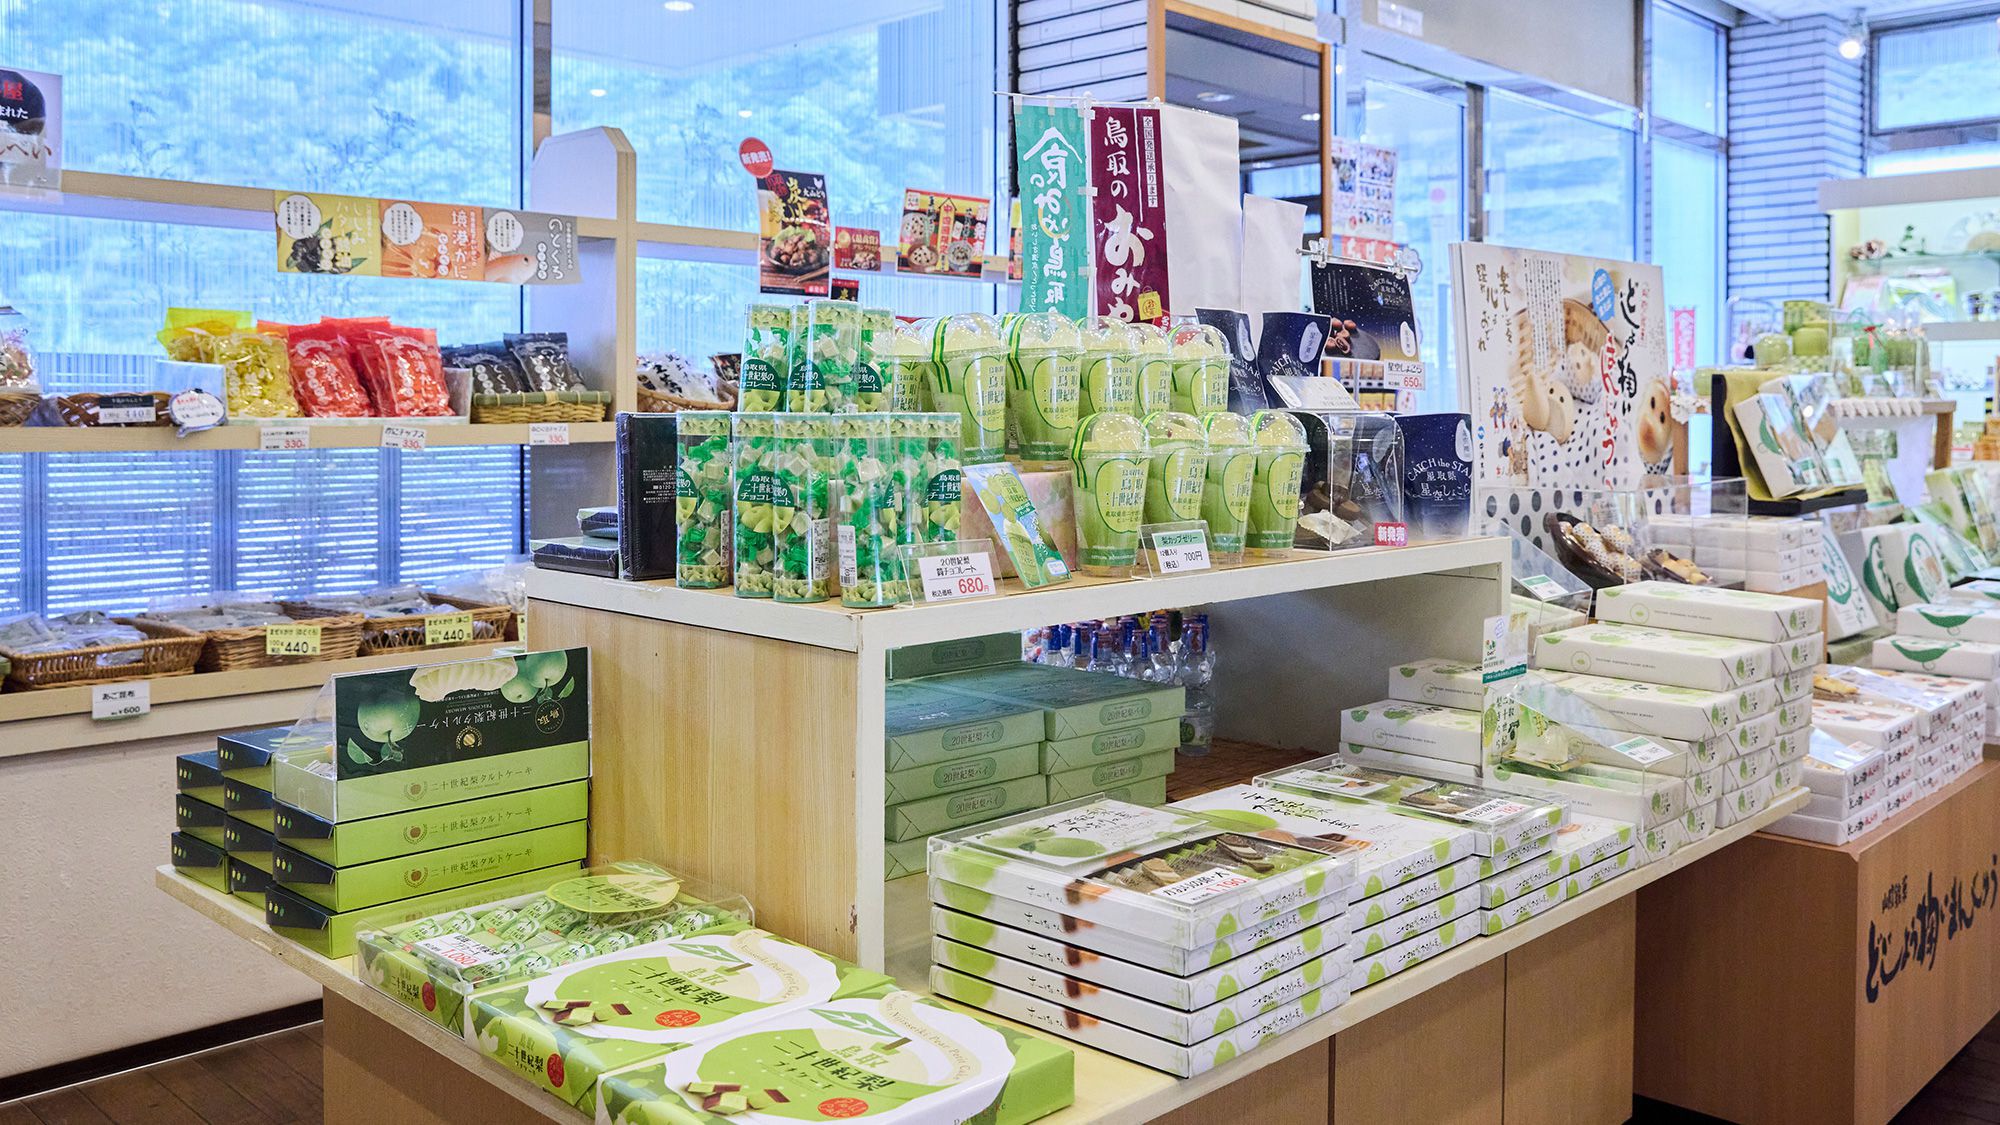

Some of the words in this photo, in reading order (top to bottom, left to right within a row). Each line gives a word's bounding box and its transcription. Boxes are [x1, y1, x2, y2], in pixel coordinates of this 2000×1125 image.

[1143, 116, 1159, 208] 全国発送承ります
[1387, 362, 1422, 374] 星空しょこら
[1407, 458, 1436, 481] CATCH
[1438, 459, 1450, 468] the
[1161, 534, 1199, 545] 梨カップゼリー
[1377, 527, 1405, 542] 新発売
[940, 557, 971, 567] 20世紀梨
[1184, 551, 1204, 562] 700円
[936, 566, 977, 577] 筒チョコレート
[958, 577, 990, 595] 680円
[102, 690, 136, 701] あご昆布
[536, 707, 561, 726] 鳥取
[1106, 706, 1146, 721] 20世紀梨パイ
[952, 730, 996, 746] 20世紀梨パイ
[430, 767, 533, 792] 二十世紀梨タルトケーキ
[943, 766, 989, 782] 20世紀梨パイ
[430, 807, 533, 833] 二十世紀梨タルトケーキ
[431, 849, 534, 876] 二十世紀梨タルトケーキ
[628, 965, 730, 1005] 二十世紀梨
[676, 967, 730, 987] 鳥取
[391, 975, 420, 1000] 二十世紀梨
[625, 979, 674, 1003] プチケーキ
[508, 1043, 544, 1073] 二十世紀梨
[773, 1040, 896, 1092] 二十世紀梨
[831, 1045, 889, 1069] 鳥取
[774, 1061, 834, 1090] プチケーキ
